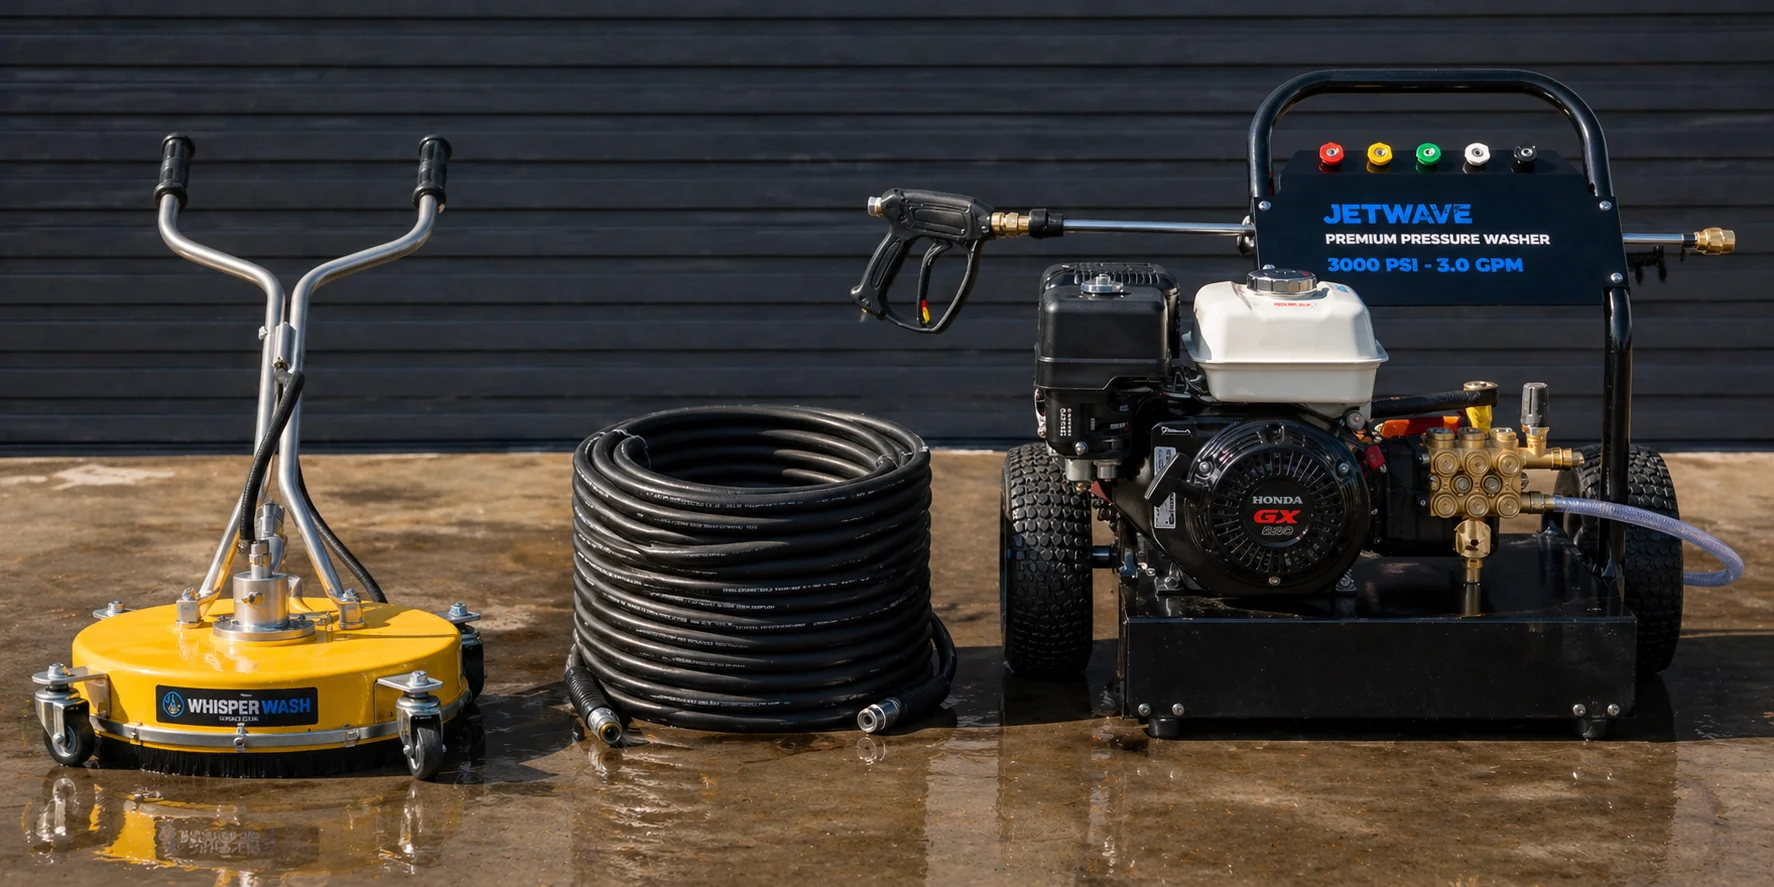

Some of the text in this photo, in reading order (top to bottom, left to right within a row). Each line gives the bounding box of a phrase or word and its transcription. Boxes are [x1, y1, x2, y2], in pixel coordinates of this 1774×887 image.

[1324, 203, 1473, 224] JETWAVE
[1325, 233, 1551, 245] PREMIUM PRESSURE WASHER
[1327, 257, 1380, 272] 3000
[1386, 257, 1418, 272] PSI
[1436, 257, 1470, 272] 3.0
[1475, 257, 1524, 272] GPM
[1252, 495, 1303, 505] HONDA
[1253, 509, 1301, 524] GX
[187, 698, 311, 715] WHISPER WASH
